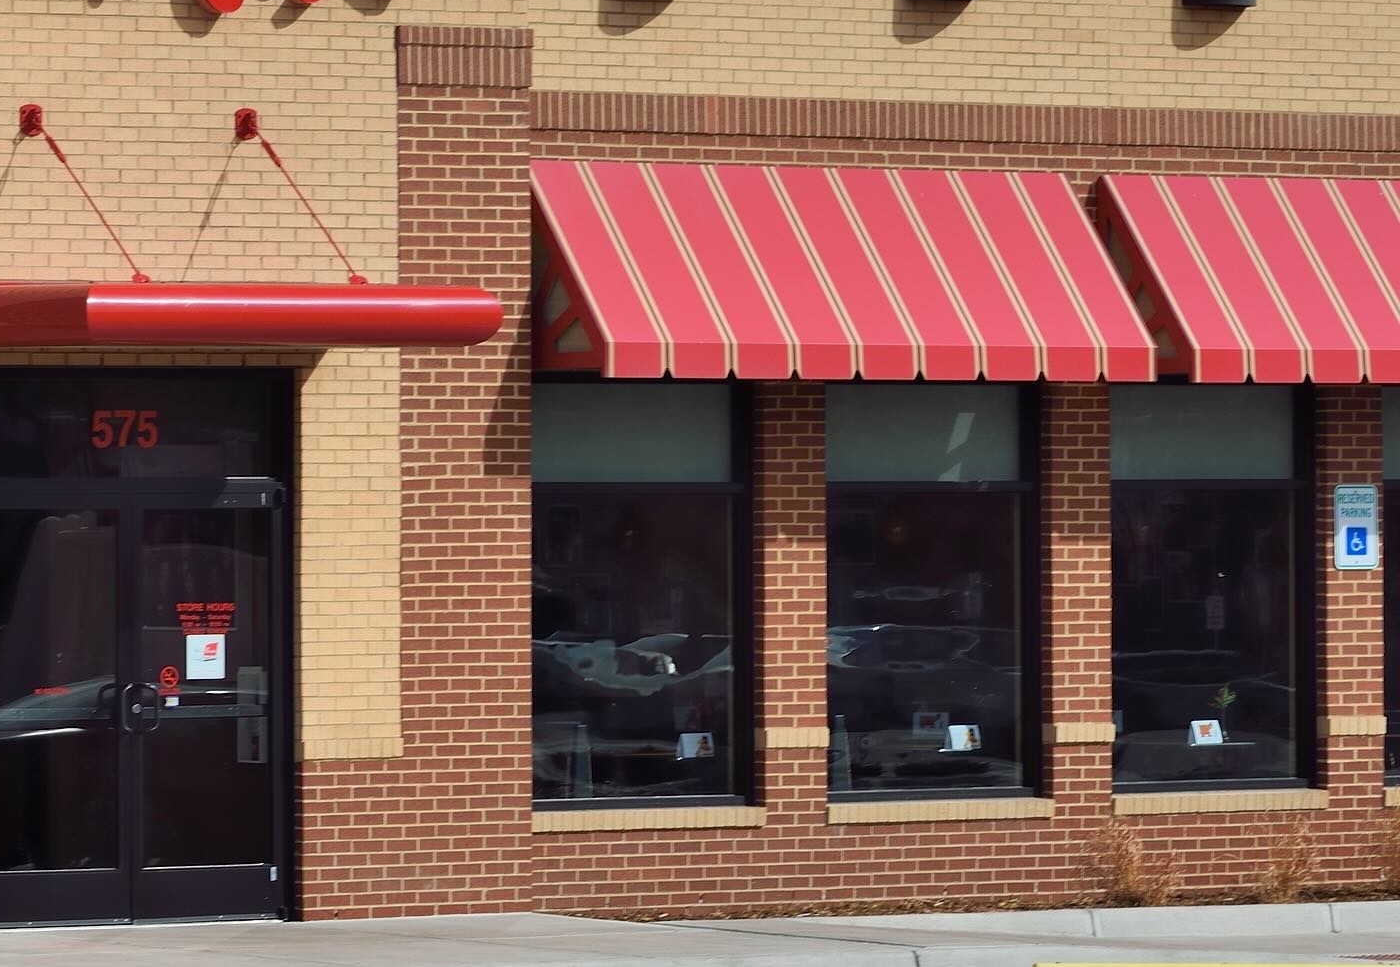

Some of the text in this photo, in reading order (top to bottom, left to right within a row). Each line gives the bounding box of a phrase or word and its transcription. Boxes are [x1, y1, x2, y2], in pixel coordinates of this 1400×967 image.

[91, 409, 158, 448] 575
[1337, 494, 1375, 504] RESERVED
[1340, 507, 1372, 518] PARKING
[176, 603, 236, 612] STORE HOURS
